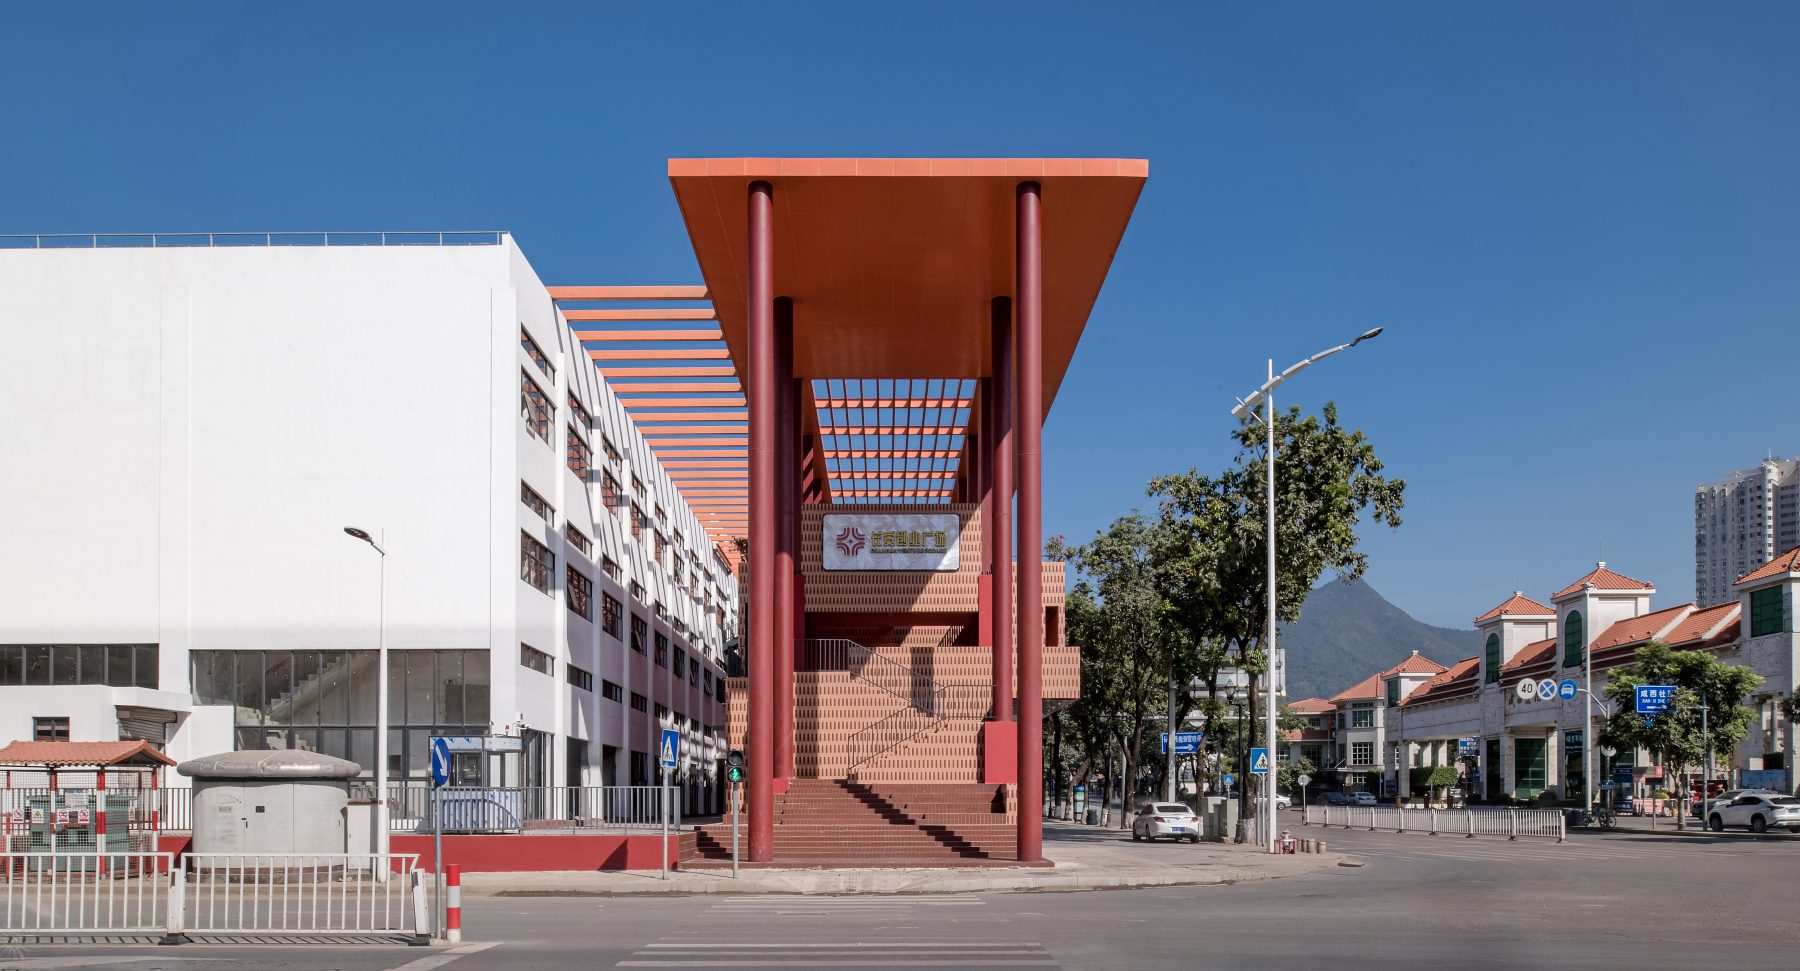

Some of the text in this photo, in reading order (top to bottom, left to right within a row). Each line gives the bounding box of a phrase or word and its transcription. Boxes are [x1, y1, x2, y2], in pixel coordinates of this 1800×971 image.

[871, 531, 947, 547] 长安创业广场
[1521, 683, 1533, 693] 40
